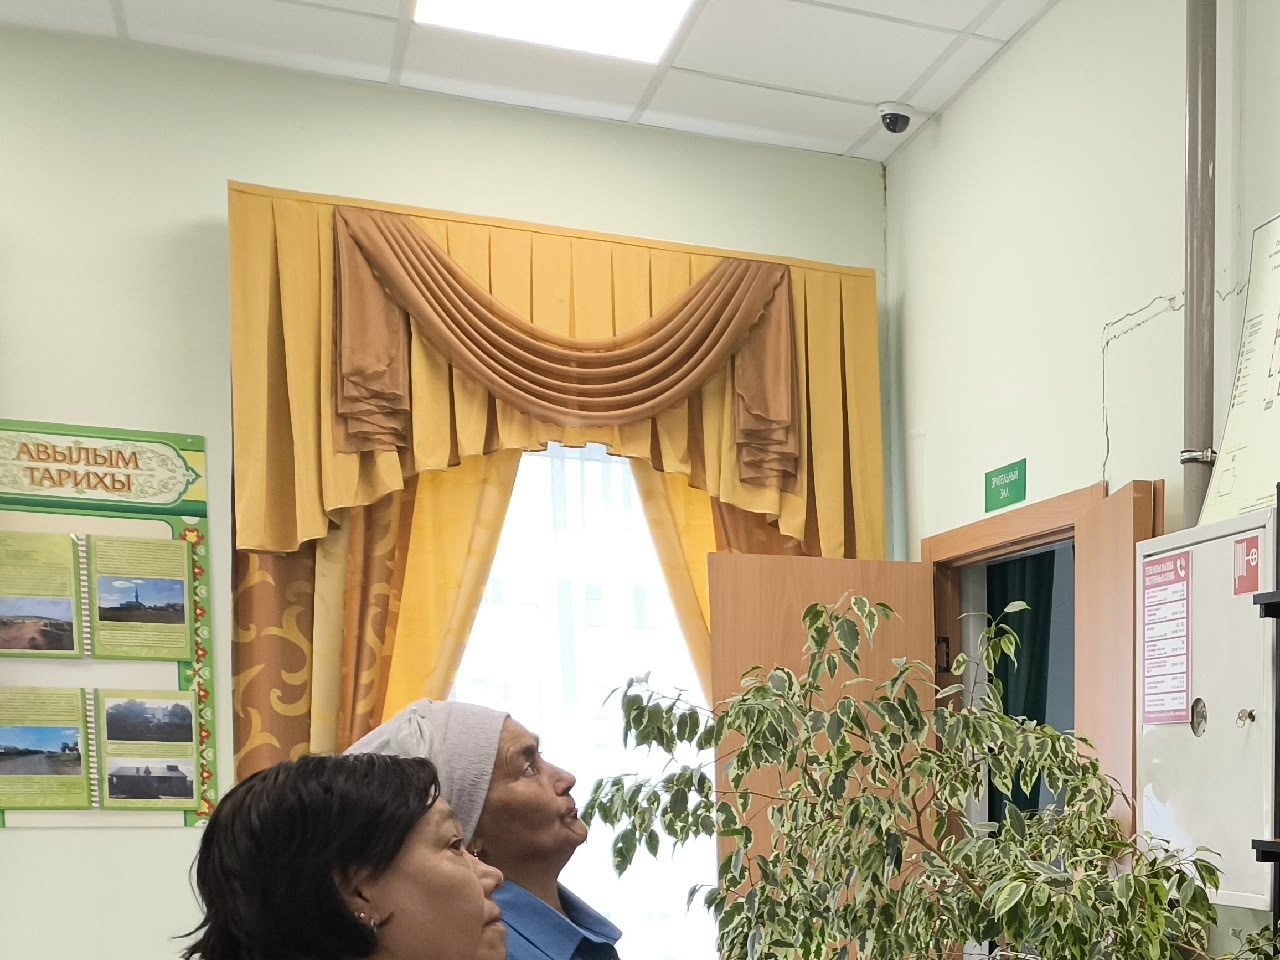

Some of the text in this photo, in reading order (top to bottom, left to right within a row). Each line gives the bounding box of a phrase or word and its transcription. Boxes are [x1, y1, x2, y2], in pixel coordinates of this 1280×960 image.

[14, 441, 141, 470] АВЫЛЫМ
[23, 466, 133, 493] ТАРИХЫ
[999, 487, 1010, 499] ЗАЛ
